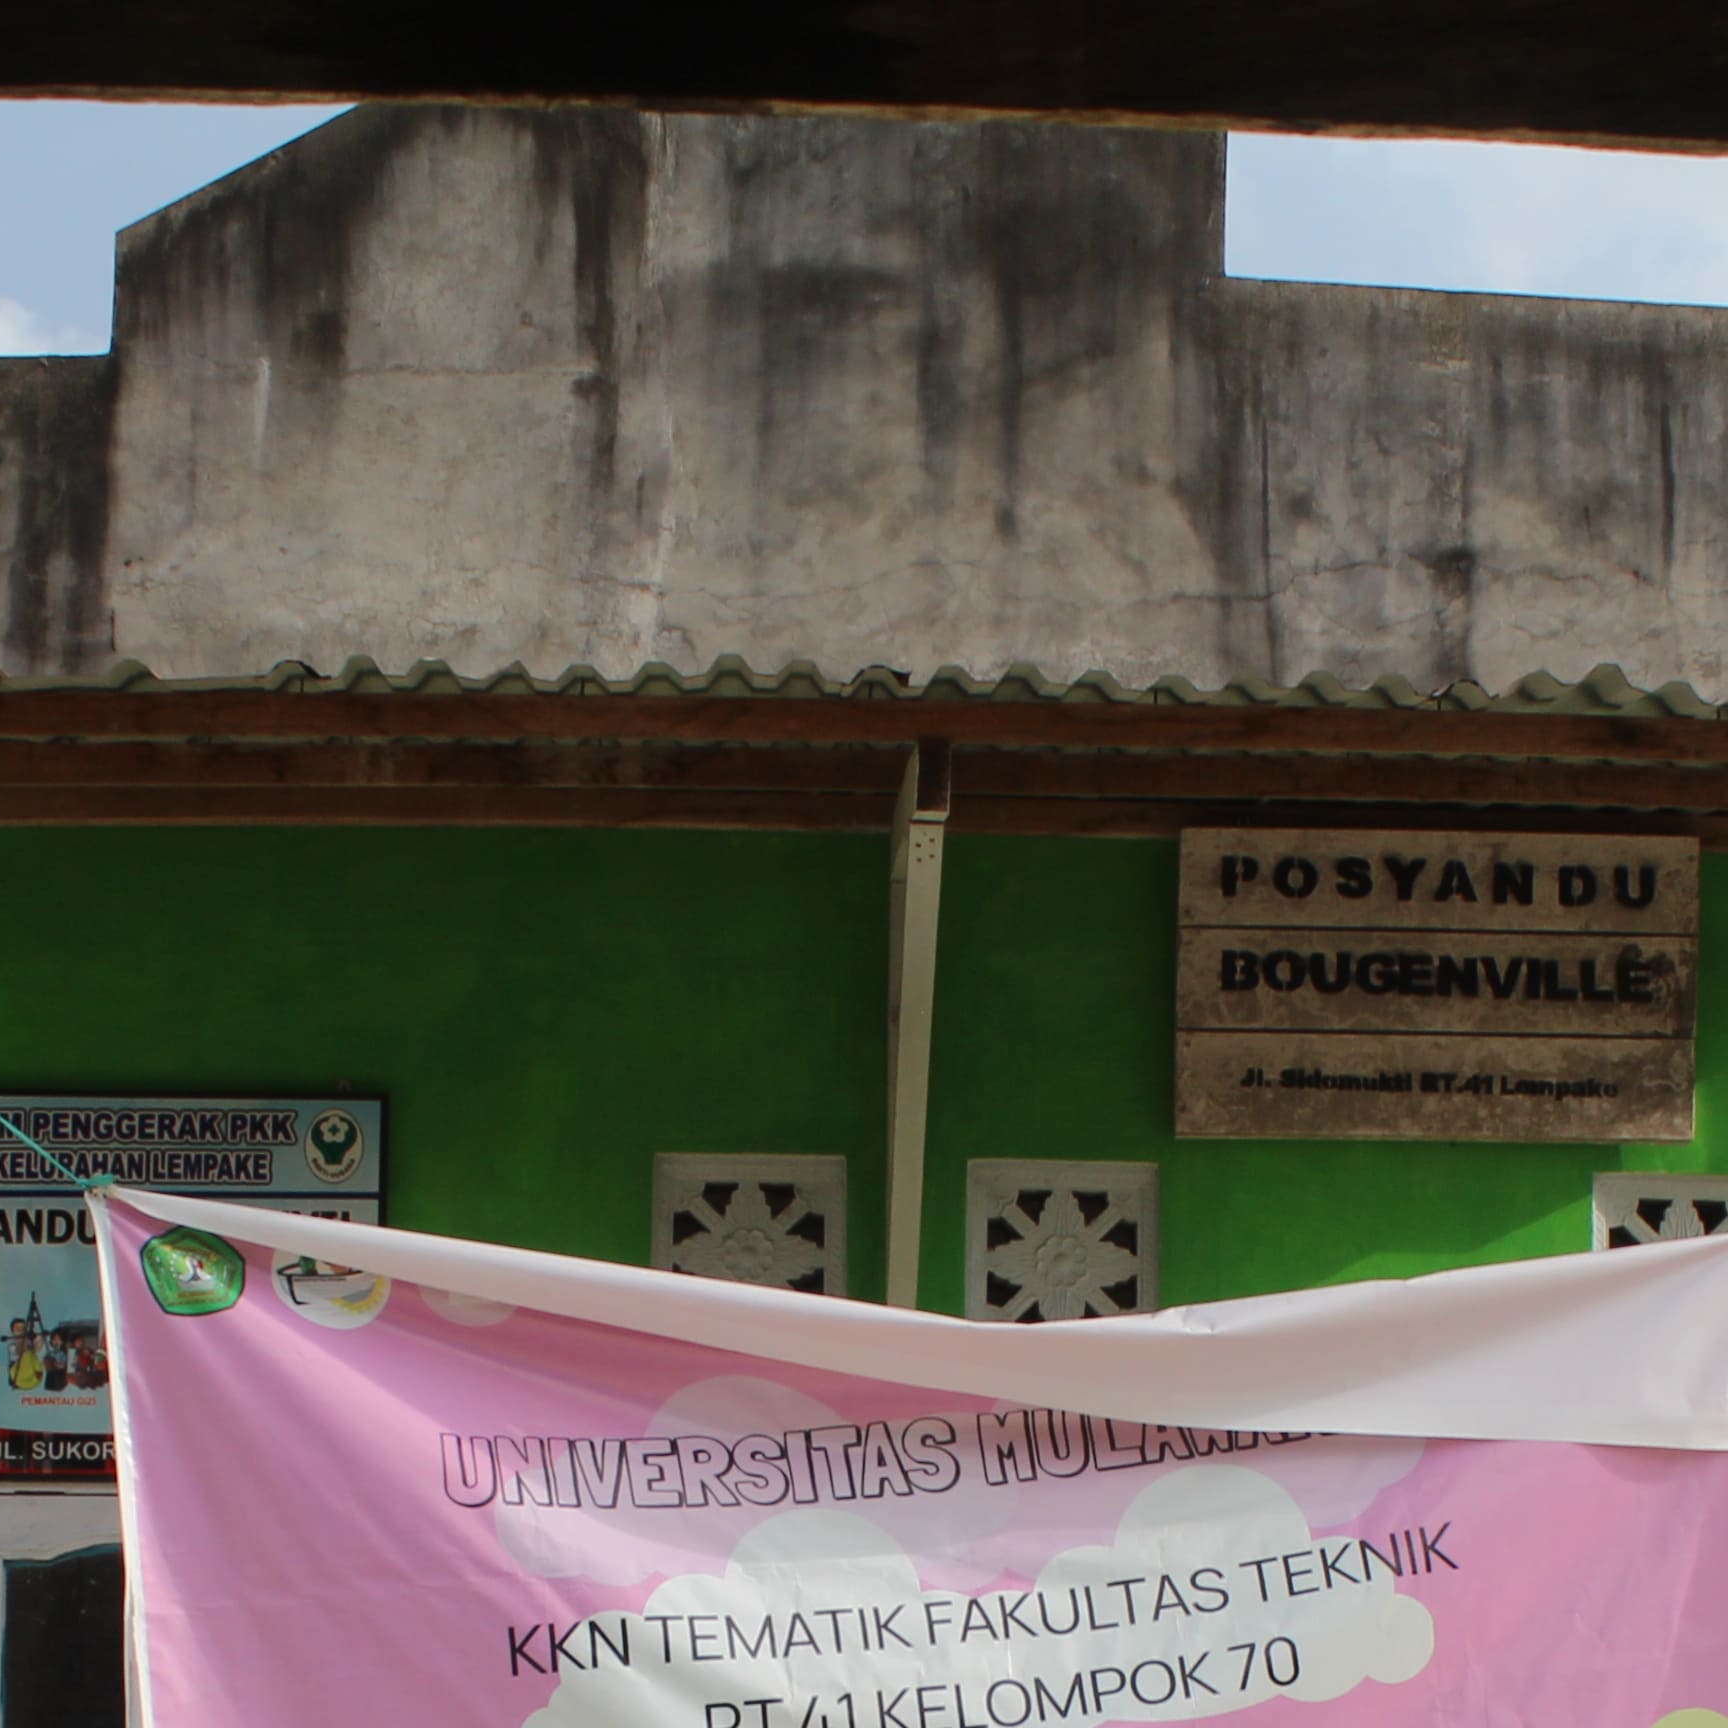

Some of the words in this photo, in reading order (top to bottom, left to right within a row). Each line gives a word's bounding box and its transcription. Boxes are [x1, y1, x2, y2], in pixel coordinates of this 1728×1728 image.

[1219, 855, 1657, 908] POSYANDU
[1219, 948, 1654, 1002] BOUGENVILLE
[31, 1110, 224, 1143] PENGGERAK
[229, 1111, 297, 1144] PKK
[152, 1152, 270, 1181] LEMPAKE
[440, 1417, 961, 1508] UNIVERSITAS
[507, 1616, 632, 1677] KKN
[643, 1603, 913, 1664] TEMATIK
[922, 1566, 1230, 1646] FAKULTAS
[1239, 1521, 1460, 1603] TEKNIK
[1227, 1635, 1301, 1692] 70
